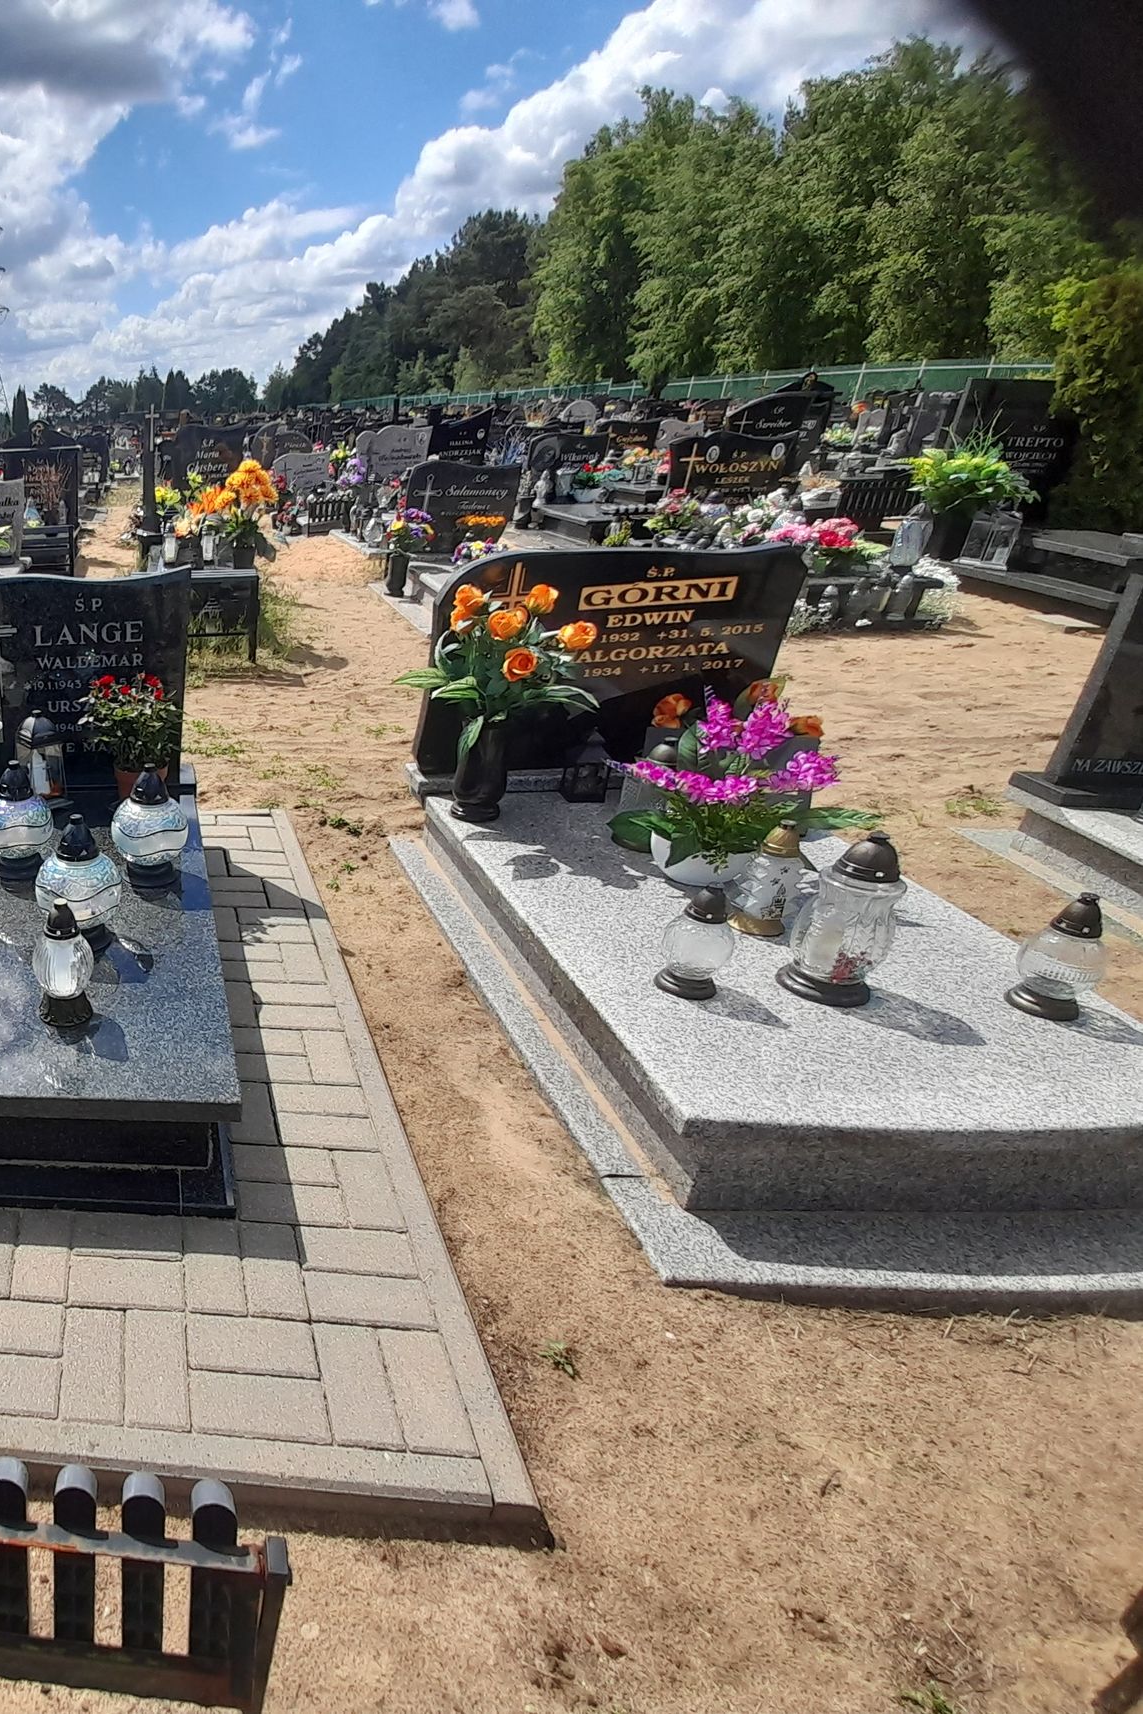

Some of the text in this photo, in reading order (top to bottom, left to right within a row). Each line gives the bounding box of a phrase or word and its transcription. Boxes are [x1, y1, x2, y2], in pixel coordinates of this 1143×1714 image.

[1007, 436, 1065, 449] TREPTO
[695, 460, 780, 475] WOŁOSZYN
[583, 580, 733, 608] GÓRNI
[606, 609, 696, 629] EDWIN
[33, 619, 145, 648] LANGE
[600, 631, 641, 644] 1932
[36, 652, 145, 671] WALDEMAR
[583, 665, 624, 679] 1934
[1071, 758, 1091, 772] NA
